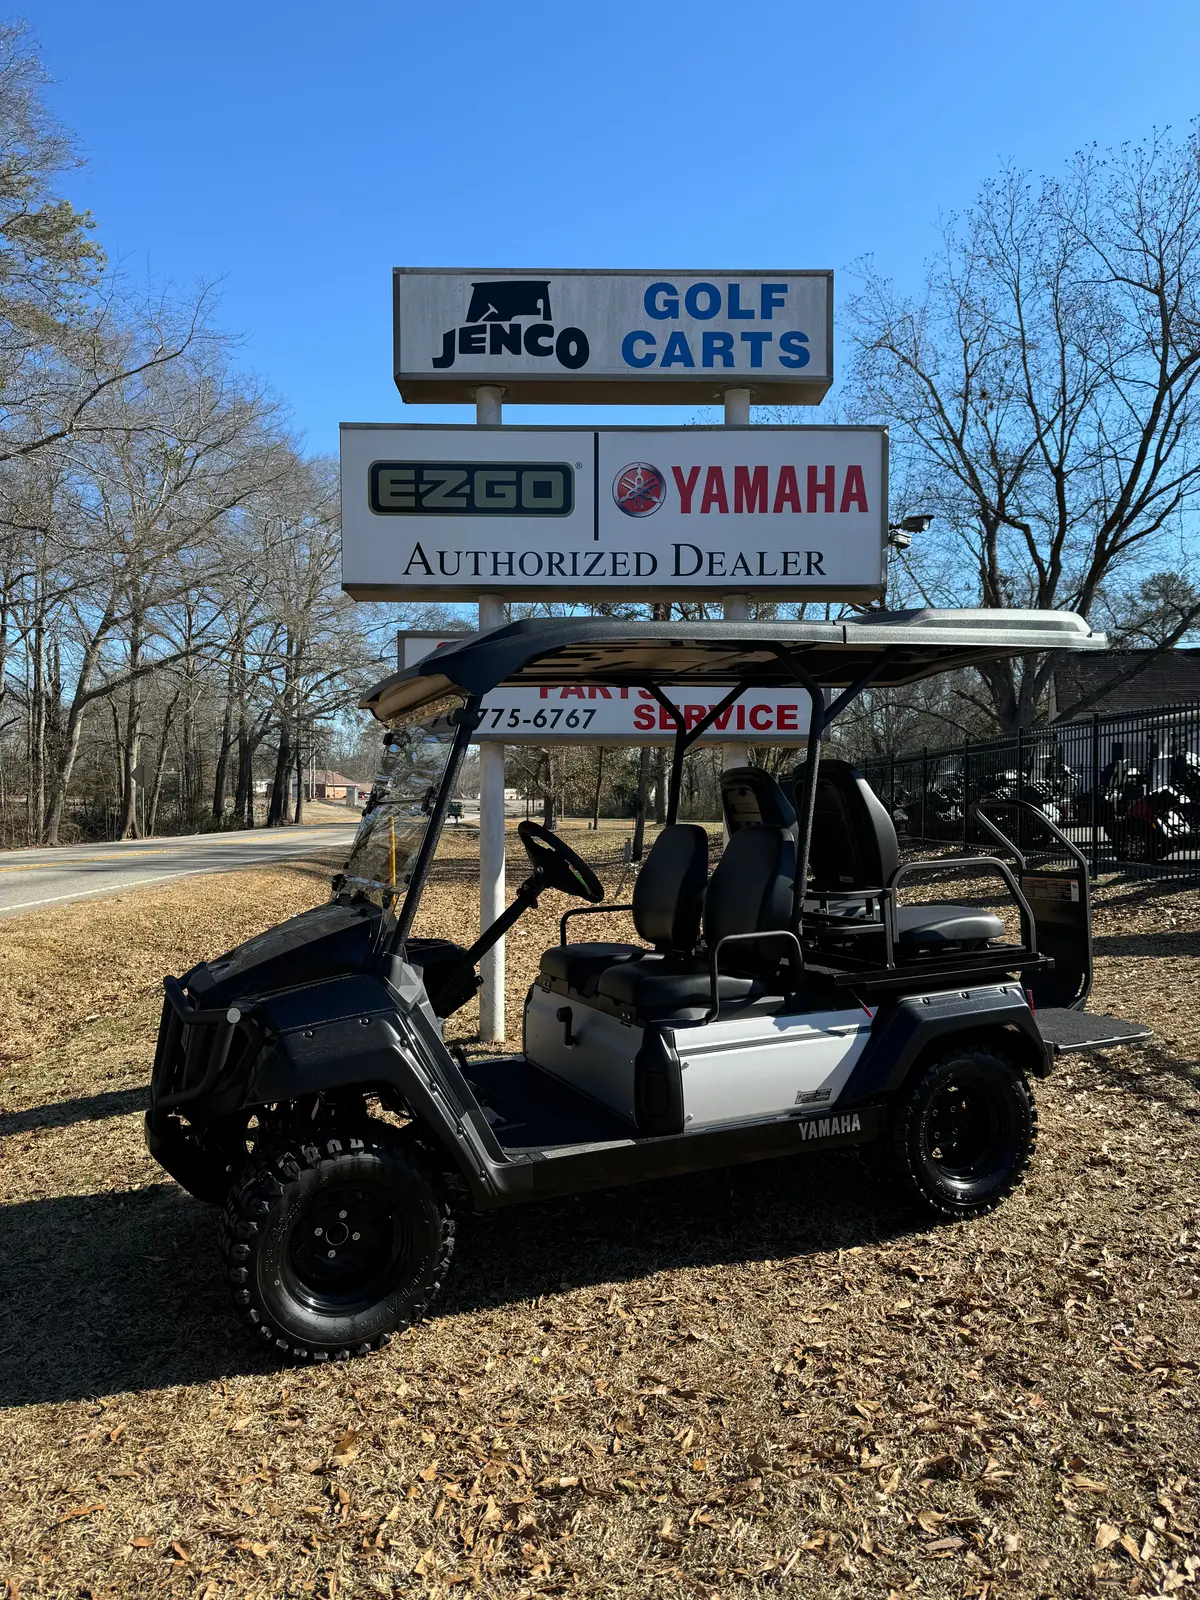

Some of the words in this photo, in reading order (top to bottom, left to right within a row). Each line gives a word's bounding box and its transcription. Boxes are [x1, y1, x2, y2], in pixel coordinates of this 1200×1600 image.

[643, 282, 788, 320] GOLF
[432, 323, 590, 370] JENCO
[621, 331, 811, 369] CARTS
[671, 466, 869, 514] YAMAHA
[633, 704, 799, 731] SERVICE
[797, 1114, 862, 1141] YAMAHA
